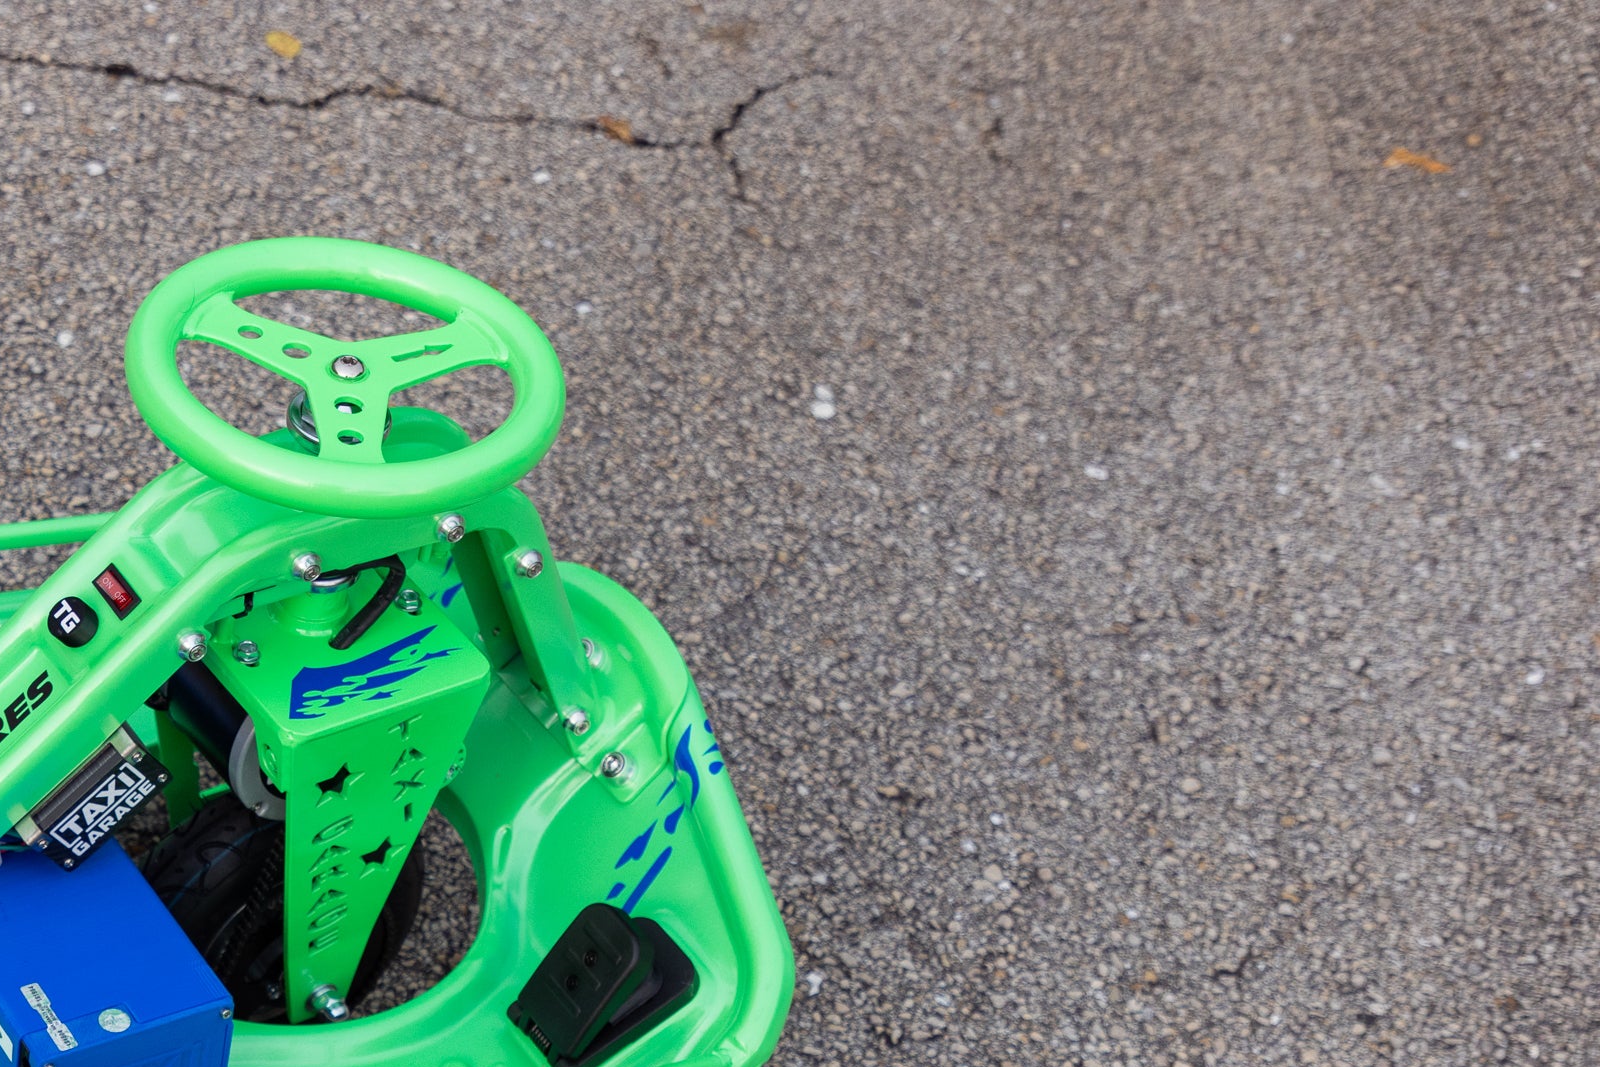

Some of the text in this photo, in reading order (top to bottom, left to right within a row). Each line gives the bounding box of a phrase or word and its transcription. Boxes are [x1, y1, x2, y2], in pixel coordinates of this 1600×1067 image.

[102, 577, 114, 589] ON
[114, 591, 127, 603] OFF
[53, 600, 81, 634] TG
[388, 714, 426, 822] TAXI
[57, 771, 137, 836] TAXI
[72, 780, 156, 857] GARAGE
